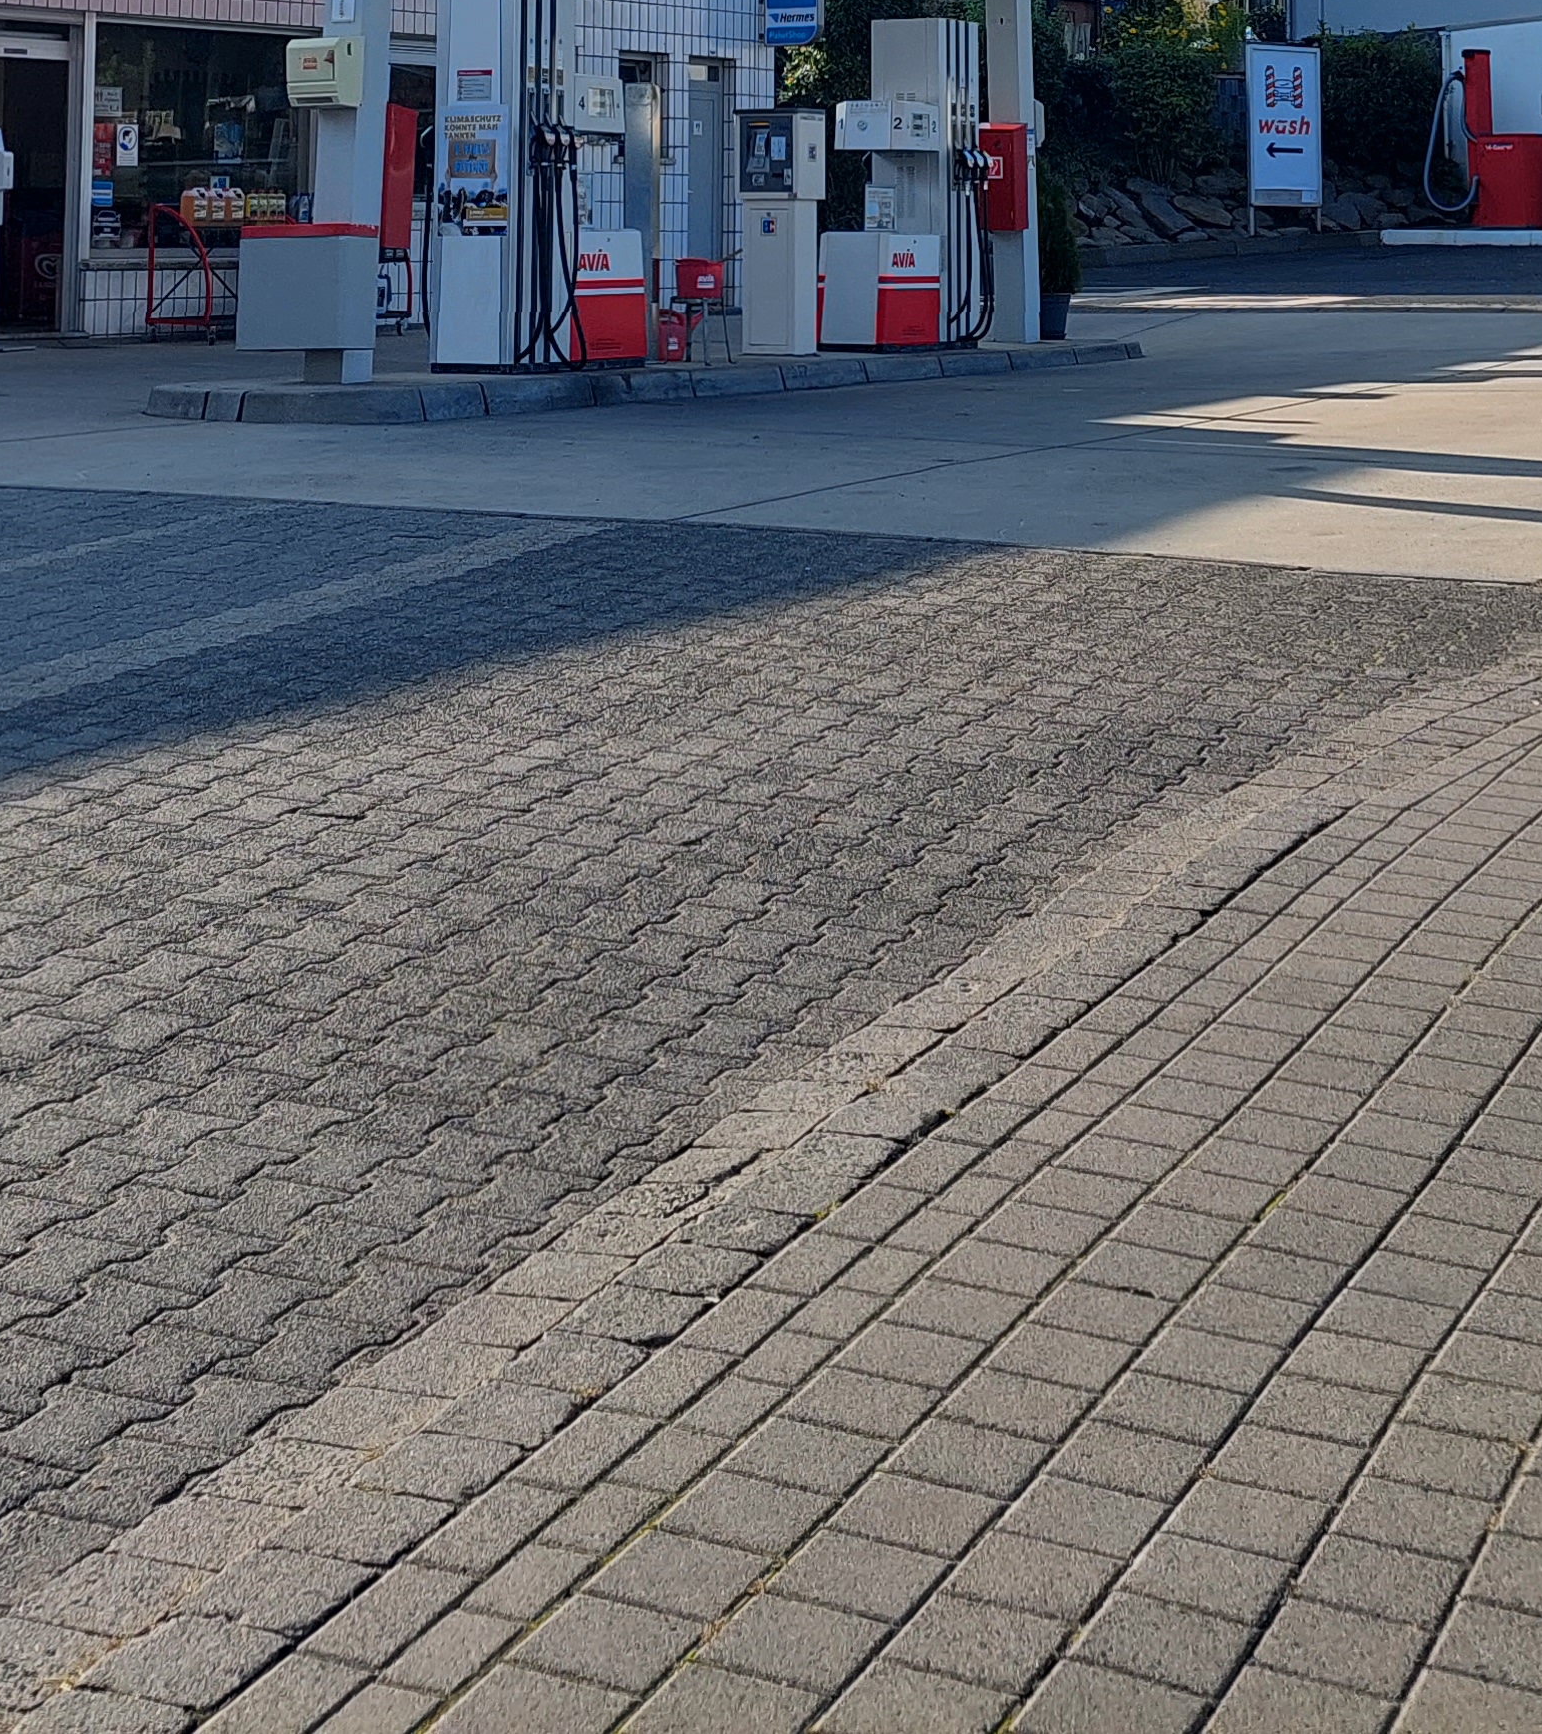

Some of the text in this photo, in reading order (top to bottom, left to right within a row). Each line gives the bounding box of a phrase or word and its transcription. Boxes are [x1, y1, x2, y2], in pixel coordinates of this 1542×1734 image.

[780, 13, 815, 23] Hermes
[579, 96, 585, 110] 4
[445, 115, 501, 123] KLIMASCHUTZ
[893, 117, 903, 130] 2
[1259, 115, 1311, 135] wash
